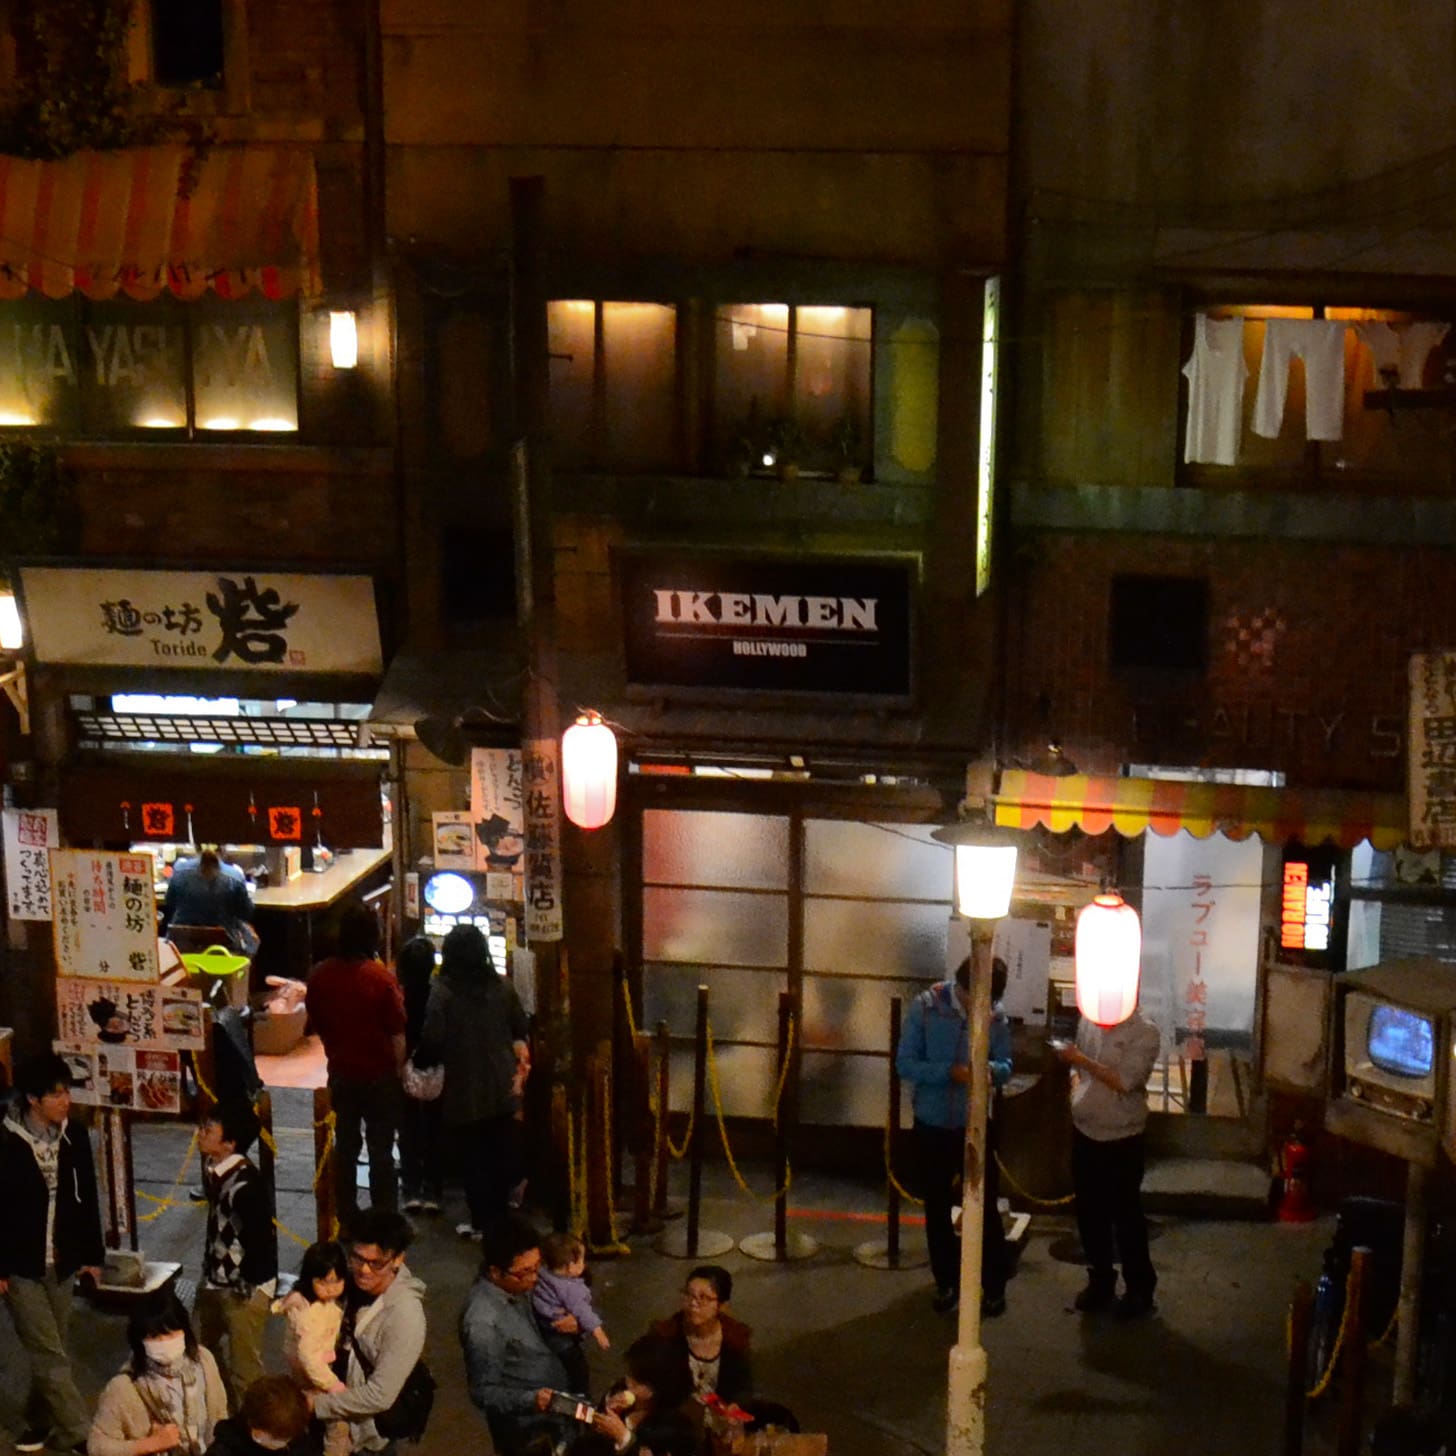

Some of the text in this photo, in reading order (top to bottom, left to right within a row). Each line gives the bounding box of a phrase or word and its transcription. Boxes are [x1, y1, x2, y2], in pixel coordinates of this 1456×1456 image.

[100, 599, 204, 636] 麺の坊
[655, 590, 879, 632] IKEMEN
[151, 639, 207, 657] Toride
[733, 640, 808, 658] HOLLYWOOD
[124, 877, 145, 933] 麺の坊
